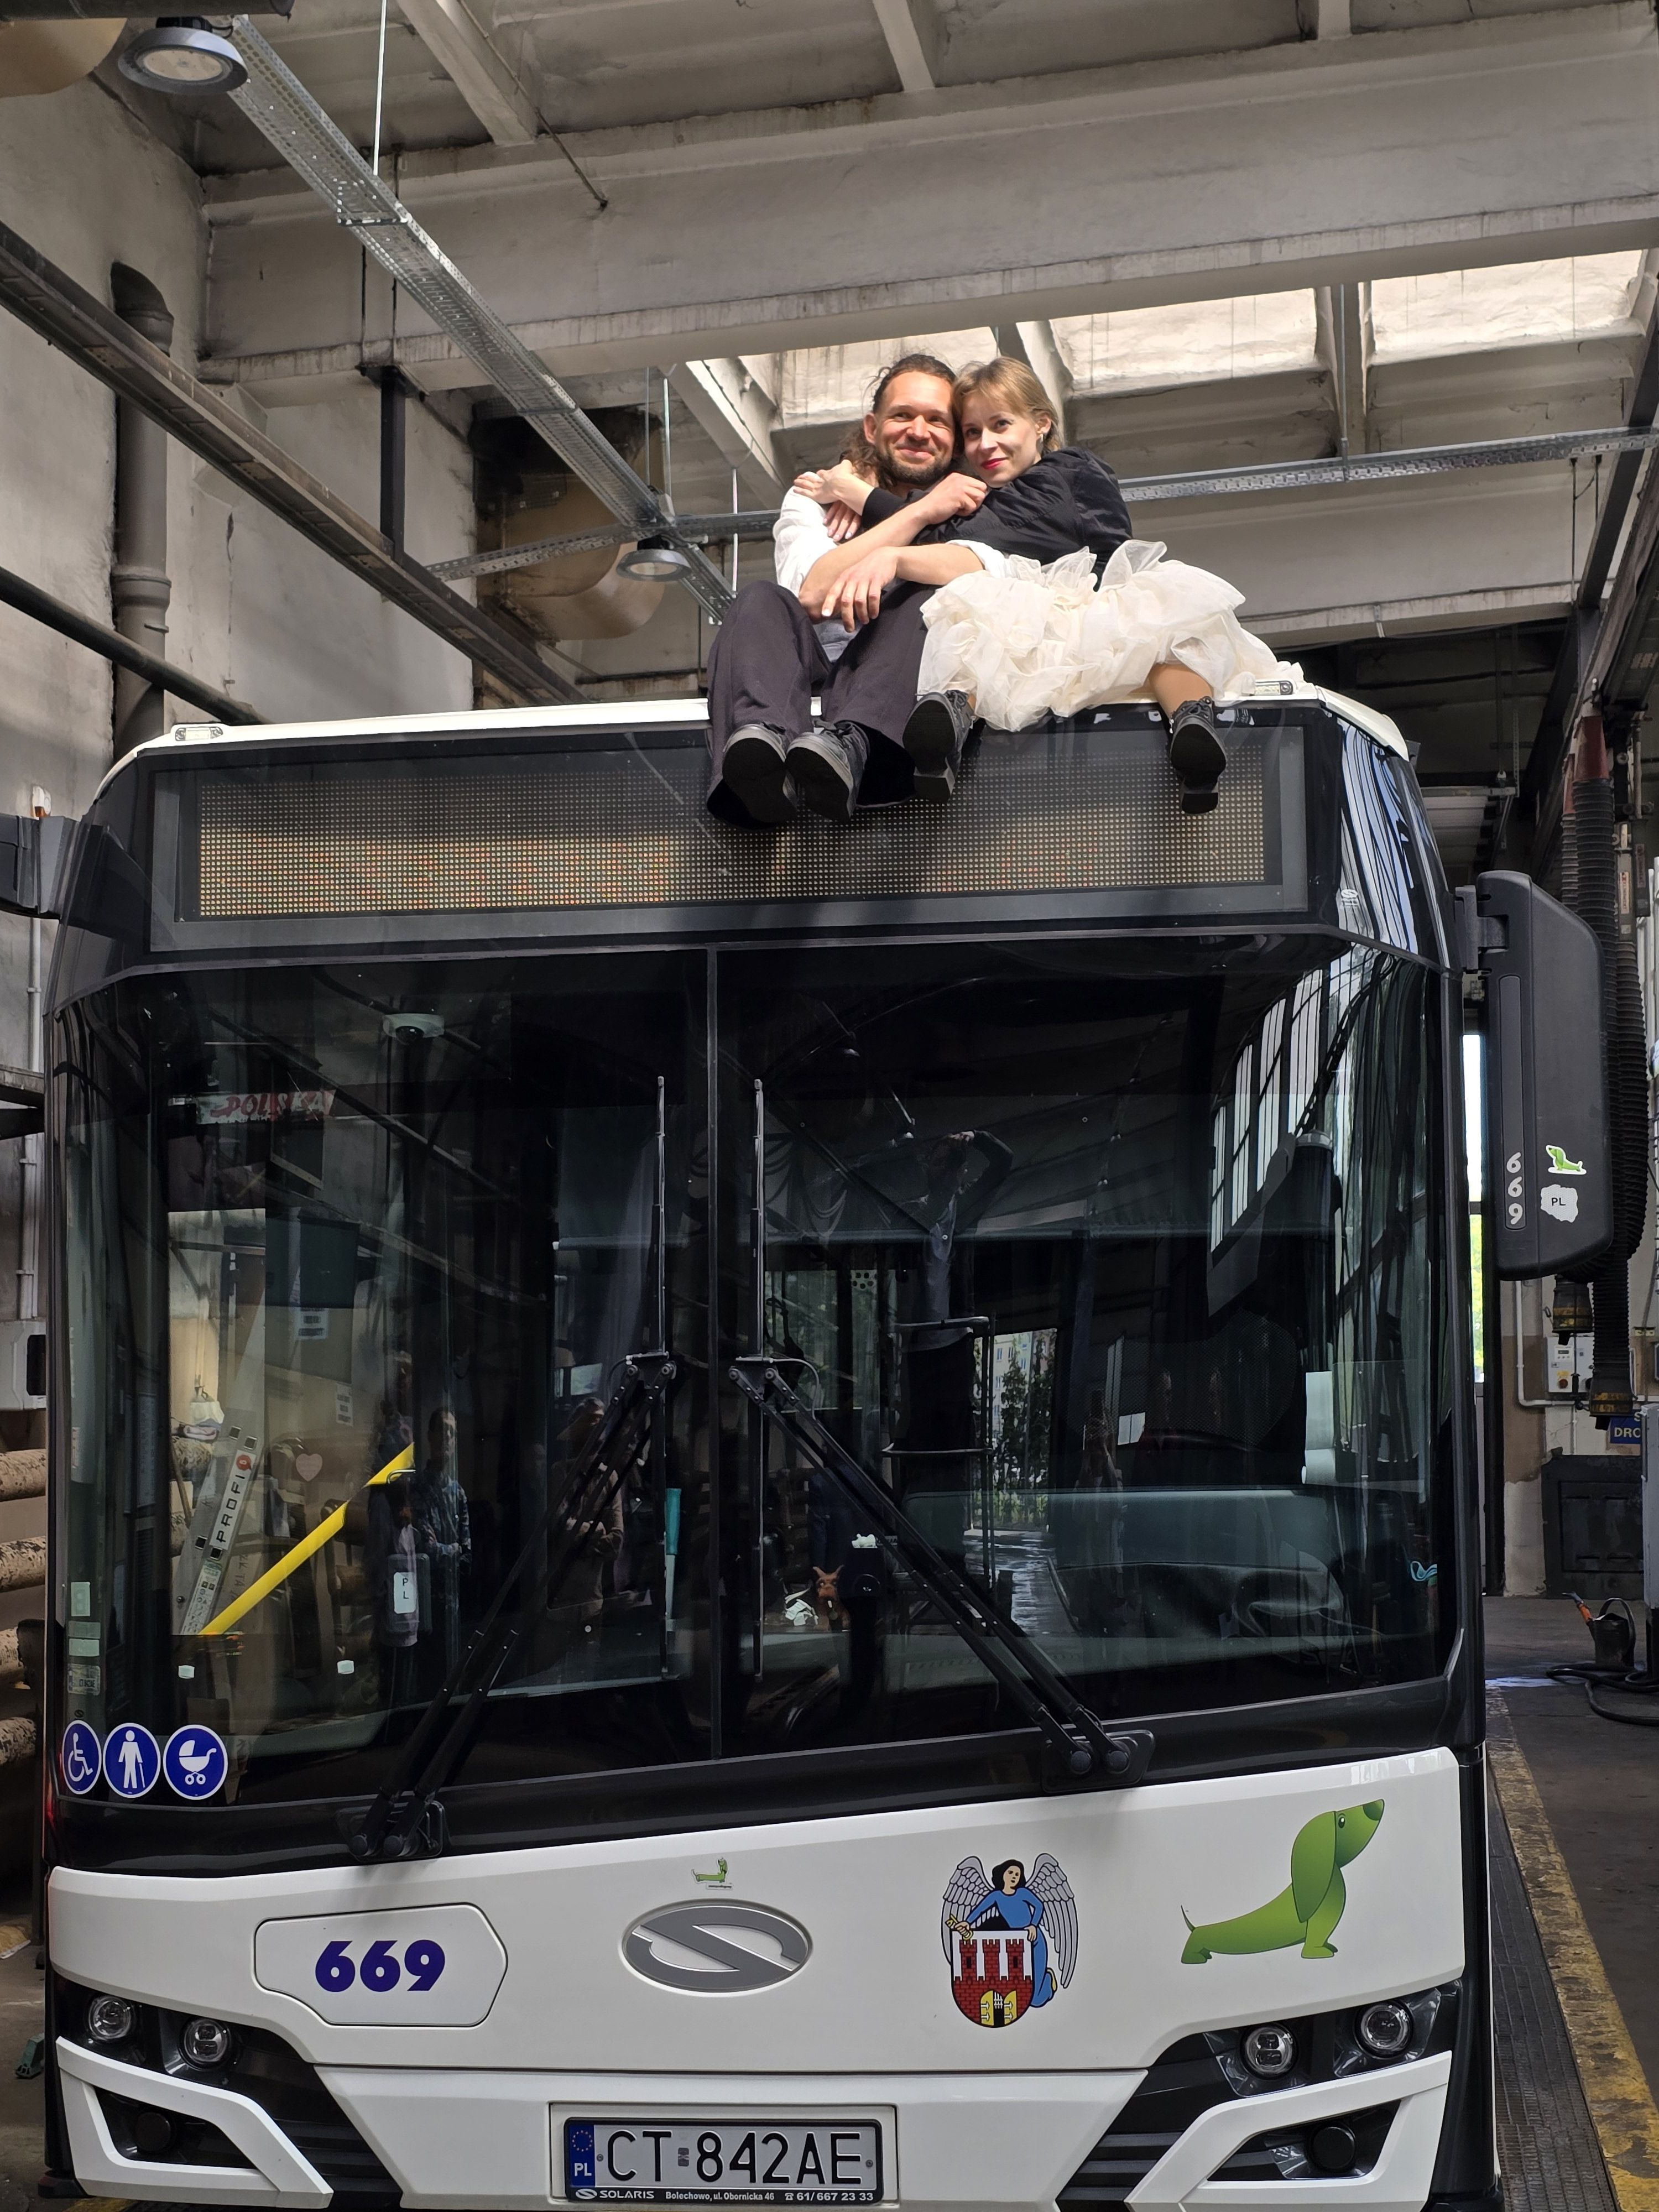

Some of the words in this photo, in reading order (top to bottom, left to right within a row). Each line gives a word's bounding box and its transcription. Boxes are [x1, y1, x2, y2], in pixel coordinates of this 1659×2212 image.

[1506, 1152, 1523, 1225] 669
[1551, 1197, 1566, 1206] PL
[216, 1474, 246, 1543] PROFI
[315, 1939, 445, 1992] 669
[574, 2163, 592, 2177] PL
[608, 2130, 672, 2182] CT
[697, 2131, 862, 2184] 842AE
[599, 2190, 655, 2199] SOLARIS
[665, 2192, 712, 2201] Bolechowo,
[724, 2192, 763, 2200] Obornicka
[841, 2193, 856, 2201] 23
[859, 2193, 874, 2201] 33
